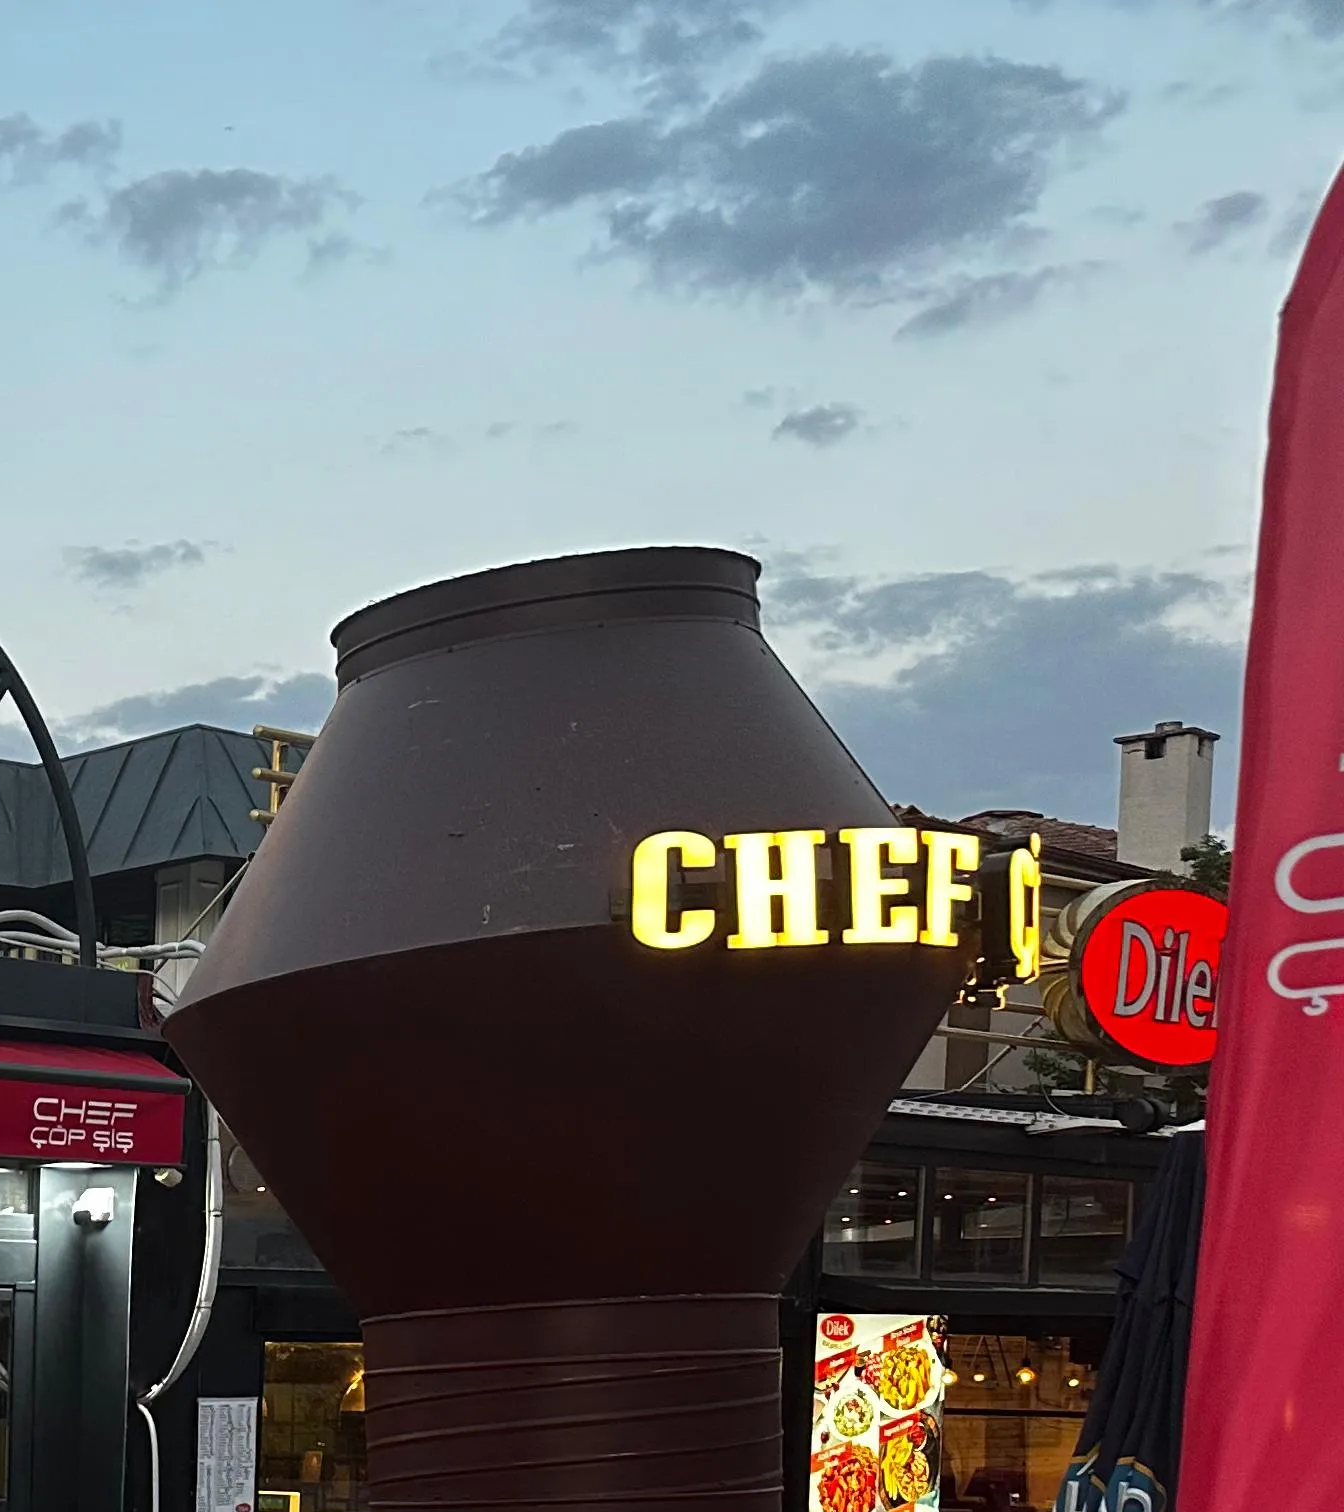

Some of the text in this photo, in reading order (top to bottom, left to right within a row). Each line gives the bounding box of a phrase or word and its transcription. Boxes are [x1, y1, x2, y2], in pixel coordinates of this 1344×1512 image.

[631, 826, 980, 950] CHEF
[1113, 920, 1218, 1028] Dile
[33, 1097, 138, 1126] CHEF
[30, 1124, 86, 1149] ÇÖP
[826, 1319, 850, 1337] Dilek
